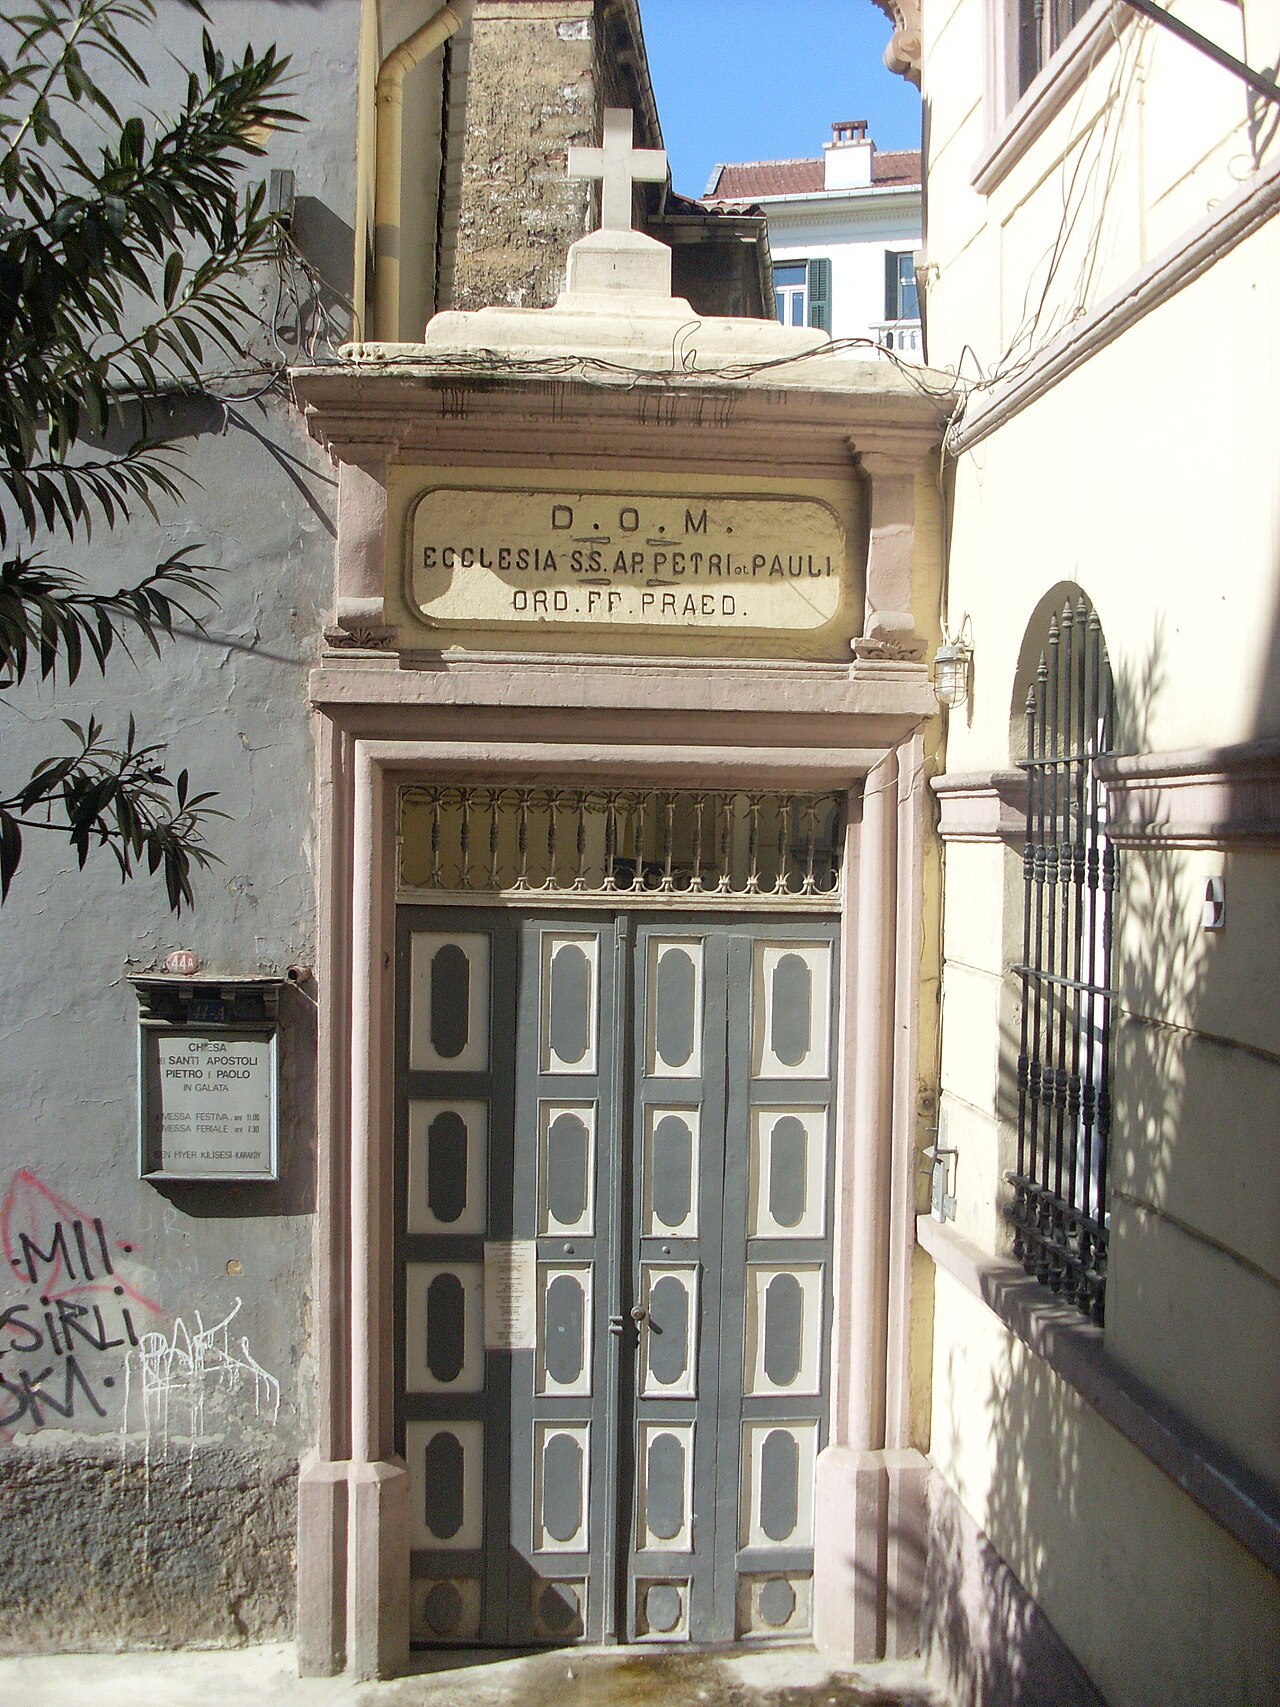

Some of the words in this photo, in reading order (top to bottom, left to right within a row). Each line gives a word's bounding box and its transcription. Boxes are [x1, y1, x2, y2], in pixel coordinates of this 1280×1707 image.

[423, 545, 558, 572] ECCLESIA
[653, 551, 731, 577] PETRI
[752, 554, 833, 579] PAULI
[168, 1055, 200, 1066] SANTI
[206, 1056, 258, 1067] APOSTOLI
[165, 1069, 204, 1079] PIETRO
[216, 1069, 251, 1080] PAOLO
[183, 1083, 192, 1092] IN
[195, 1083, 229, 1093] GALATA
